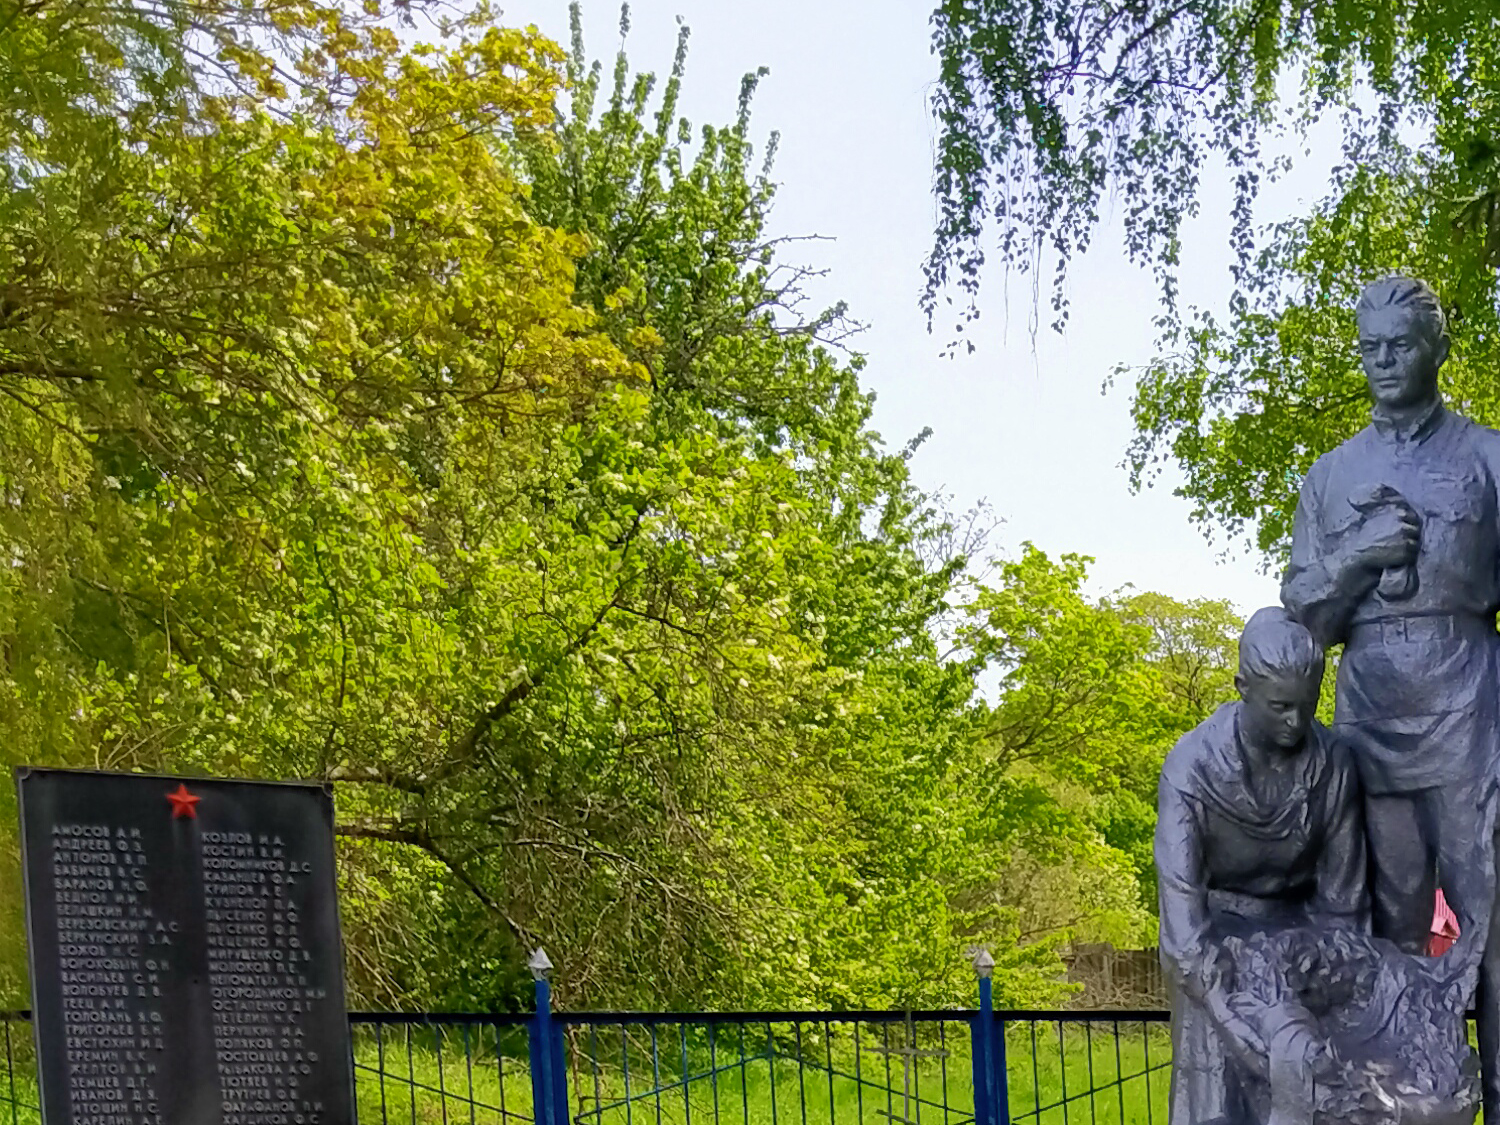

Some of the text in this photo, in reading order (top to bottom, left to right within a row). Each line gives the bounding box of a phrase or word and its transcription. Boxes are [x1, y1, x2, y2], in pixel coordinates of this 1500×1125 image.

[52, 825, 110, 838] АМОСОВ
[53, 838, 111, 850] АНДРЕЕВ
[201, 832, 252, 844] КОЗЛОВ
[202, 846, 254, 857] КОСТИН
[54, 852, 116, 864] АНТОНОВ
[54, 878, 114, 891] БАРАНОВ
[64, 1012, 132, 1022] ГОЛОВАНЬ
[65, 1024, 134, 1036] ГРИГОРЬЕВ
[70, 1089, 123, 1101] ИВАНОВ
